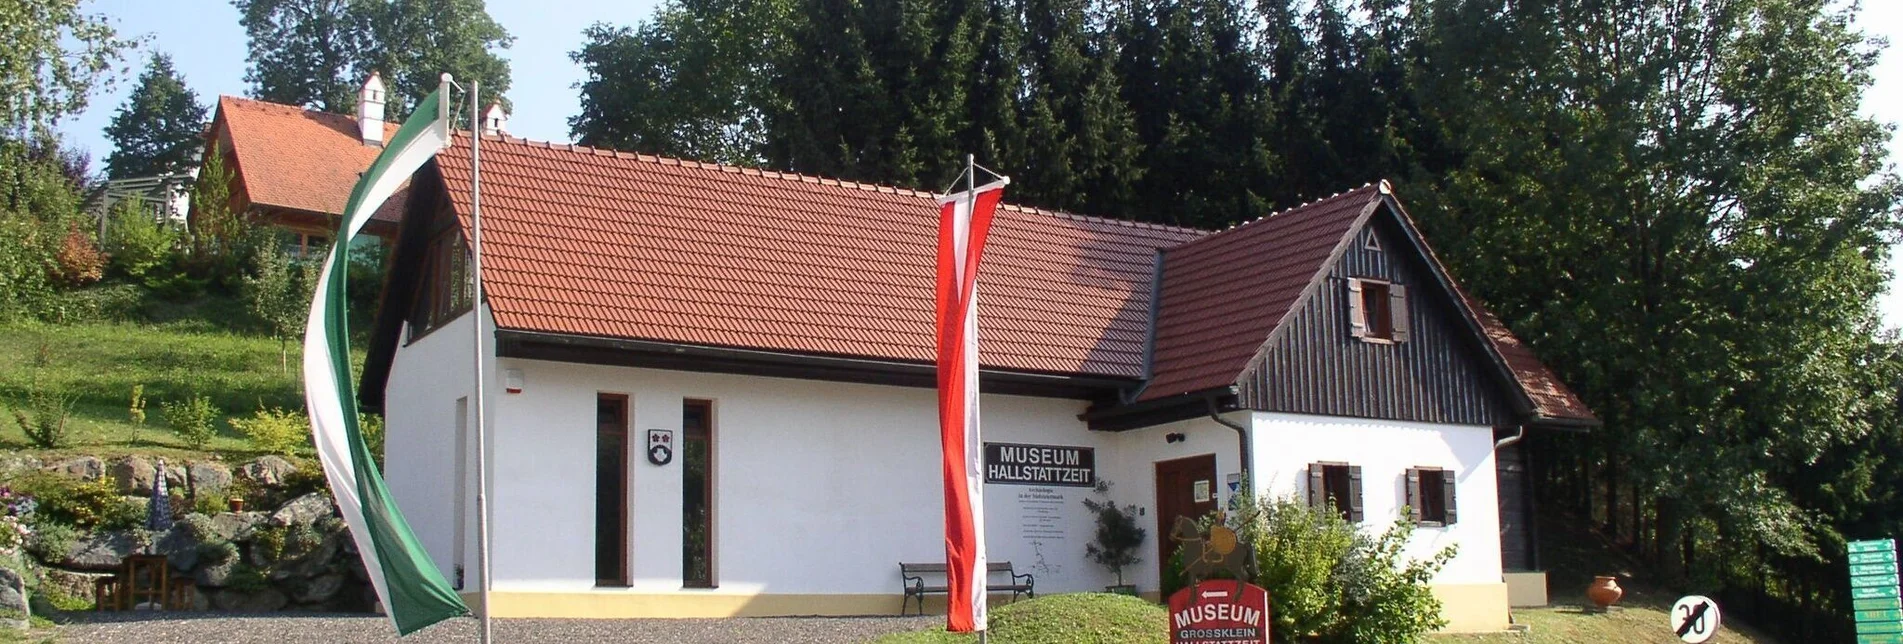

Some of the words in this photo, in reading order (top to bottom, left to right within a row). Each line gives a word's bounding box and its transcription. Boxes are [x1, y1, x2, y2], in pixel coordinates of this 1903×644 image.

[1000, 446, 1079, 465] MUSEUM
[988, 464, 1091, 483] HALLSTATTZEIT
[1174, 603, 1260, 629] MUSEUM
[1180, 628, 1256, 639] GROSSKLEIN
